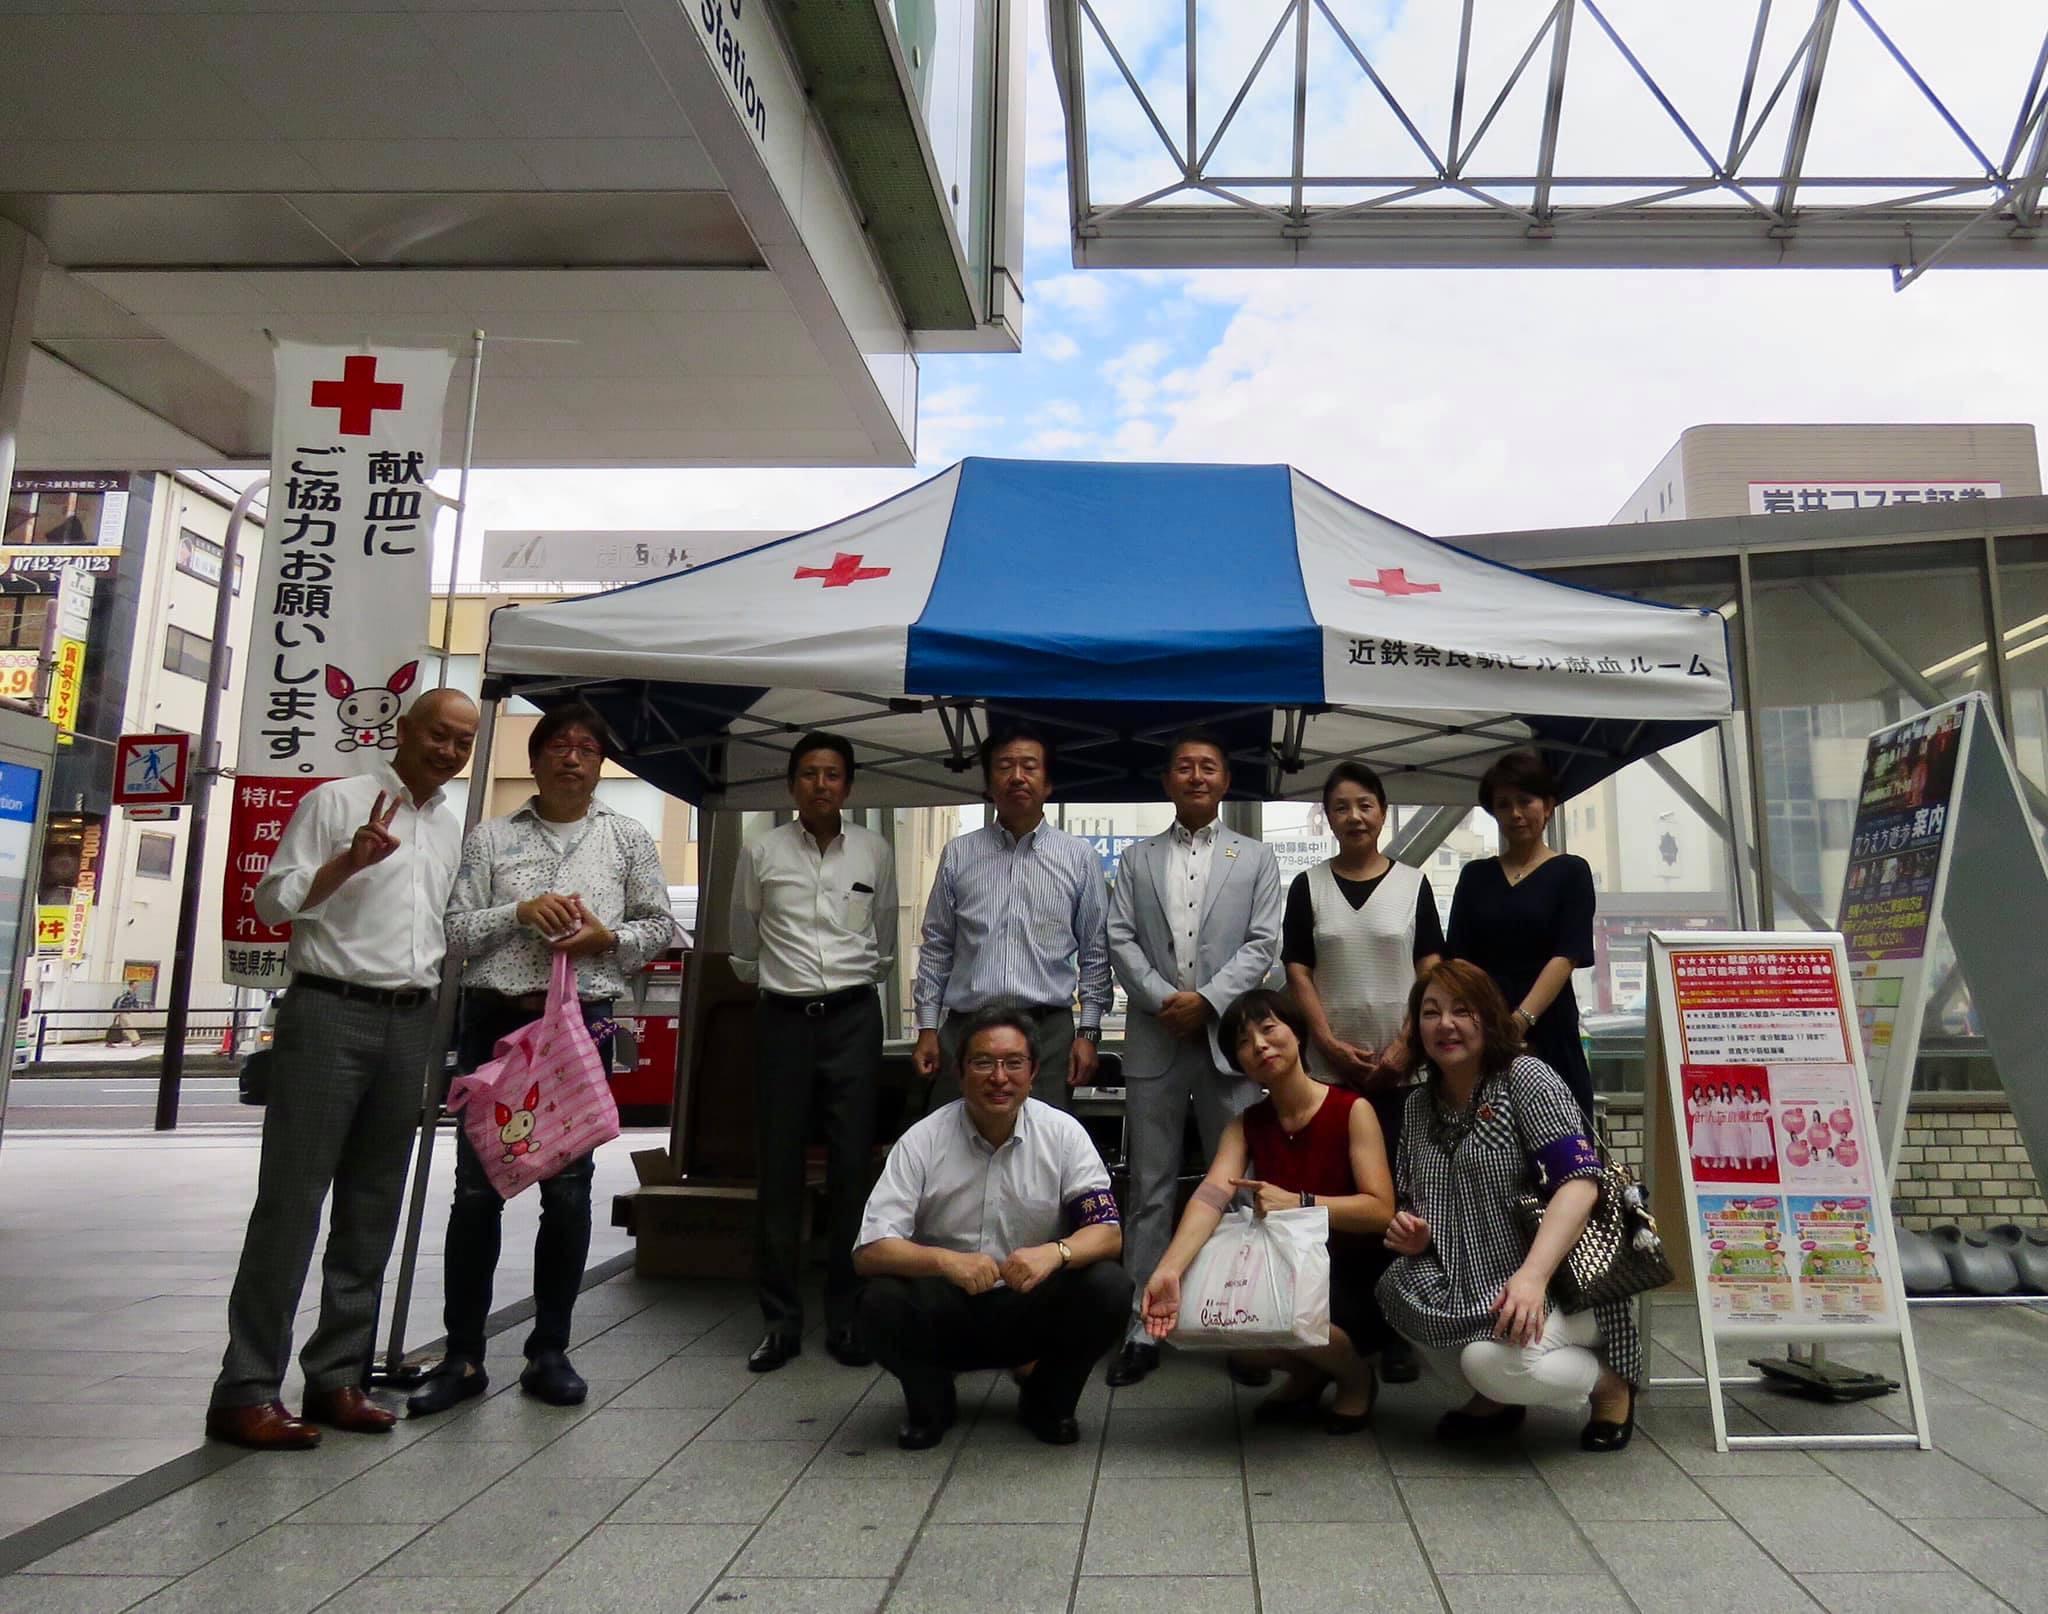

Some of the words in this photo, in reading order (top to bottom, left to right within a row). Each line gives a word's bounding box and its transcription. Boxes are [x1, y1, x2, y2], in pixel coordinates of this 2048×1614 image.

[364, 451, 424, 556] 献血に
[261, 446, 346, 774] ご協力お願いします。
[242, 787, 294, 808] 特に
